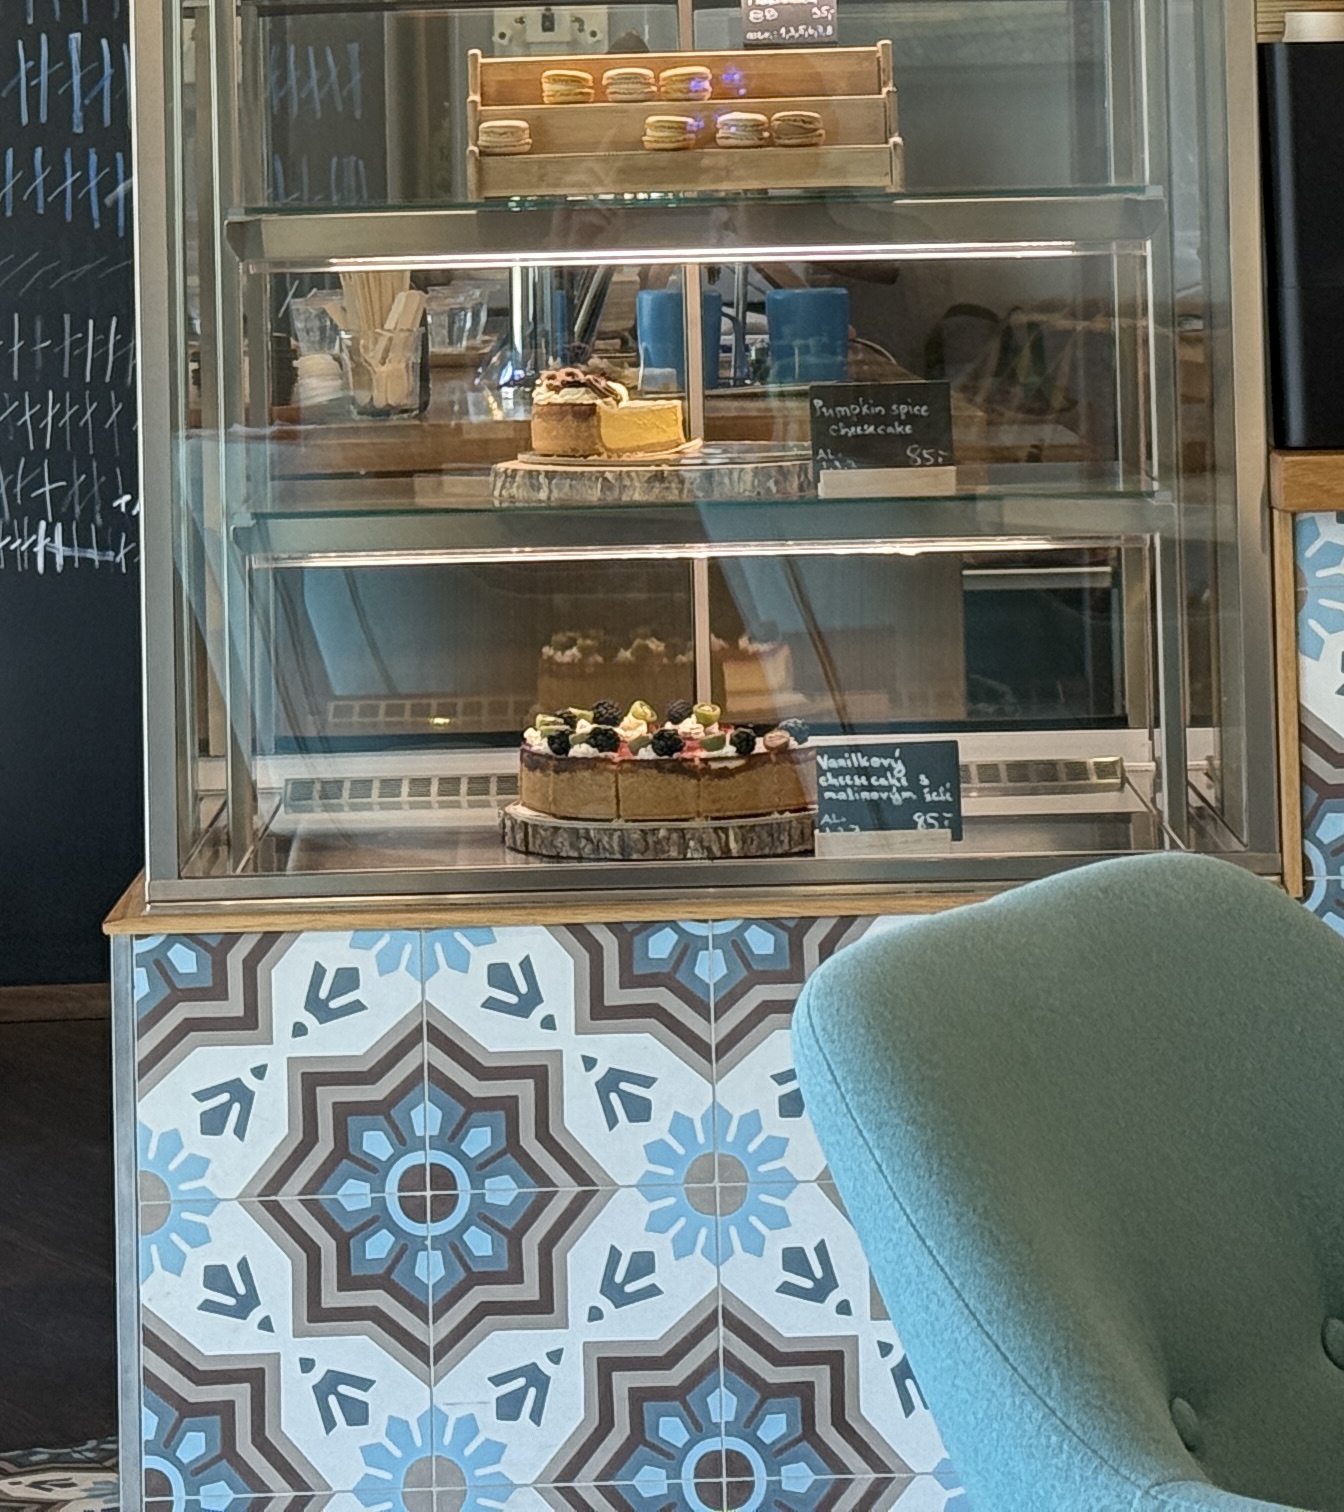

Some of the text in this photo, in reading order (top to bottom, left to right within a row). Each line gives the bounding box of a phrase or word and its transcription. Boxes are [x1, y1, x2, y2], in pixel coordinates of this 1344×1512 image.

[813, 397, 930, 420] Pumpkin spice
[829, 421, 913, 437] cheesecake
[817, 748, 906, 777] Vanilkový
[919, 774, 930, 786] s
[824, 786, 917, 805] malinovým
